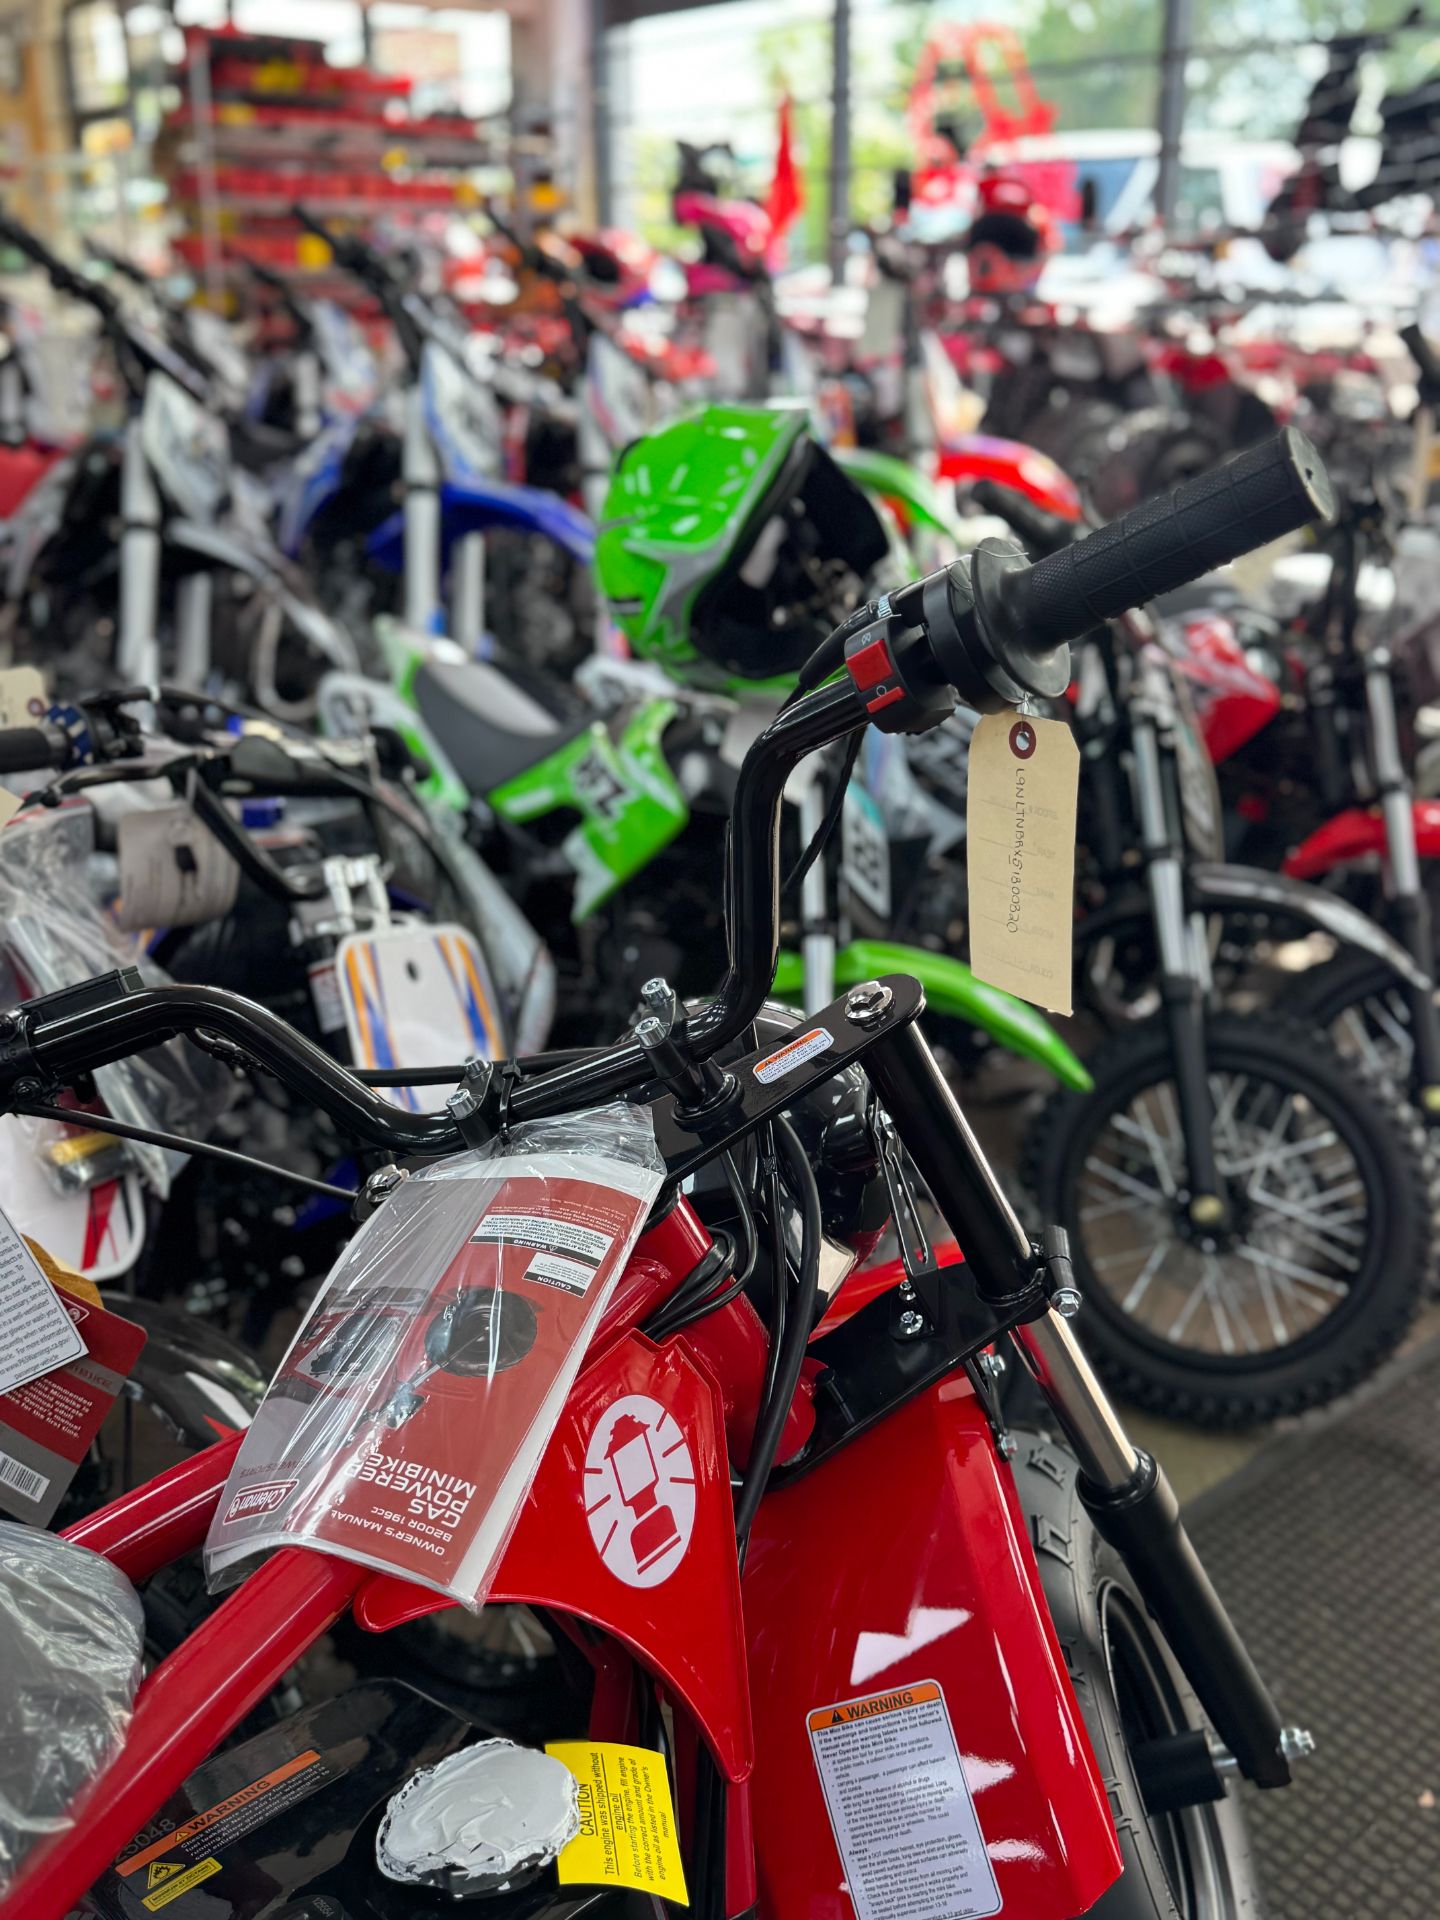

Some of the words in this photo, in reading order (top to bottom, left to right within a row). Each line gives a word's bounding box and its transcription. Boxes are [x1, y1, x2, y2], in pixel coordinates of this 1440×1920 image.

[513, 1239, 548, 1249] WARNING
[537, 1276, 572, 1290] CAUTION
[368, 1451, 475, 1497] MINIBIKE
[240, 1488, 286, 1510] Coleman
[332, 1510, 382, 1531] MANUAL
[372, 1507, 405, 1524] 196cc
[409, 1499, 460, 1527] GAS
[386, 1527, 444, 1555] OWNER'S
[408, 1520, 452, 1541] B200R
[847, 1692, 913, 1718] WARNING
[590, 1752, 601, 1777] without
[618, 1757, 628, 1777] engine
[628, 1758, 636, 1766] of
[630, 1767, 641, 1785] grade
[642, 1766, 652, 1792] Owner's
[593, 1779, 606, 1808] shipped
[610, 1793, 619, 1803] oil
[633, 1785, 642, 1798] and
[646, 1794, 654, 1805] the
[189, 1780, 270, 1831] WARNING
[575, 1783, 594, 1836] CAUTION
[635, 1799, 645, 1825] amount
[600, 1811, 608, 1825] was
[613, 1805, 626, 1830] engine
[648, 1813, 658, 1833] listed
[659, 1811, 669, 1838] manual
[601, 1828, 613, 1855] engine
[629, 1825, 638, 1852] starting
[640, 1826, 649, 1851] correct
[652, 1843, 661, 1854] oil
[653, 1835, 660, 1843] as
[604, 1857, 614, 1874] This
[633, 1854, 642, 1878] Before
[644, 1852, 652, 1864] the
[656, 1855, 666, 1880] engine
[645, 1866, 654, 1881] with
